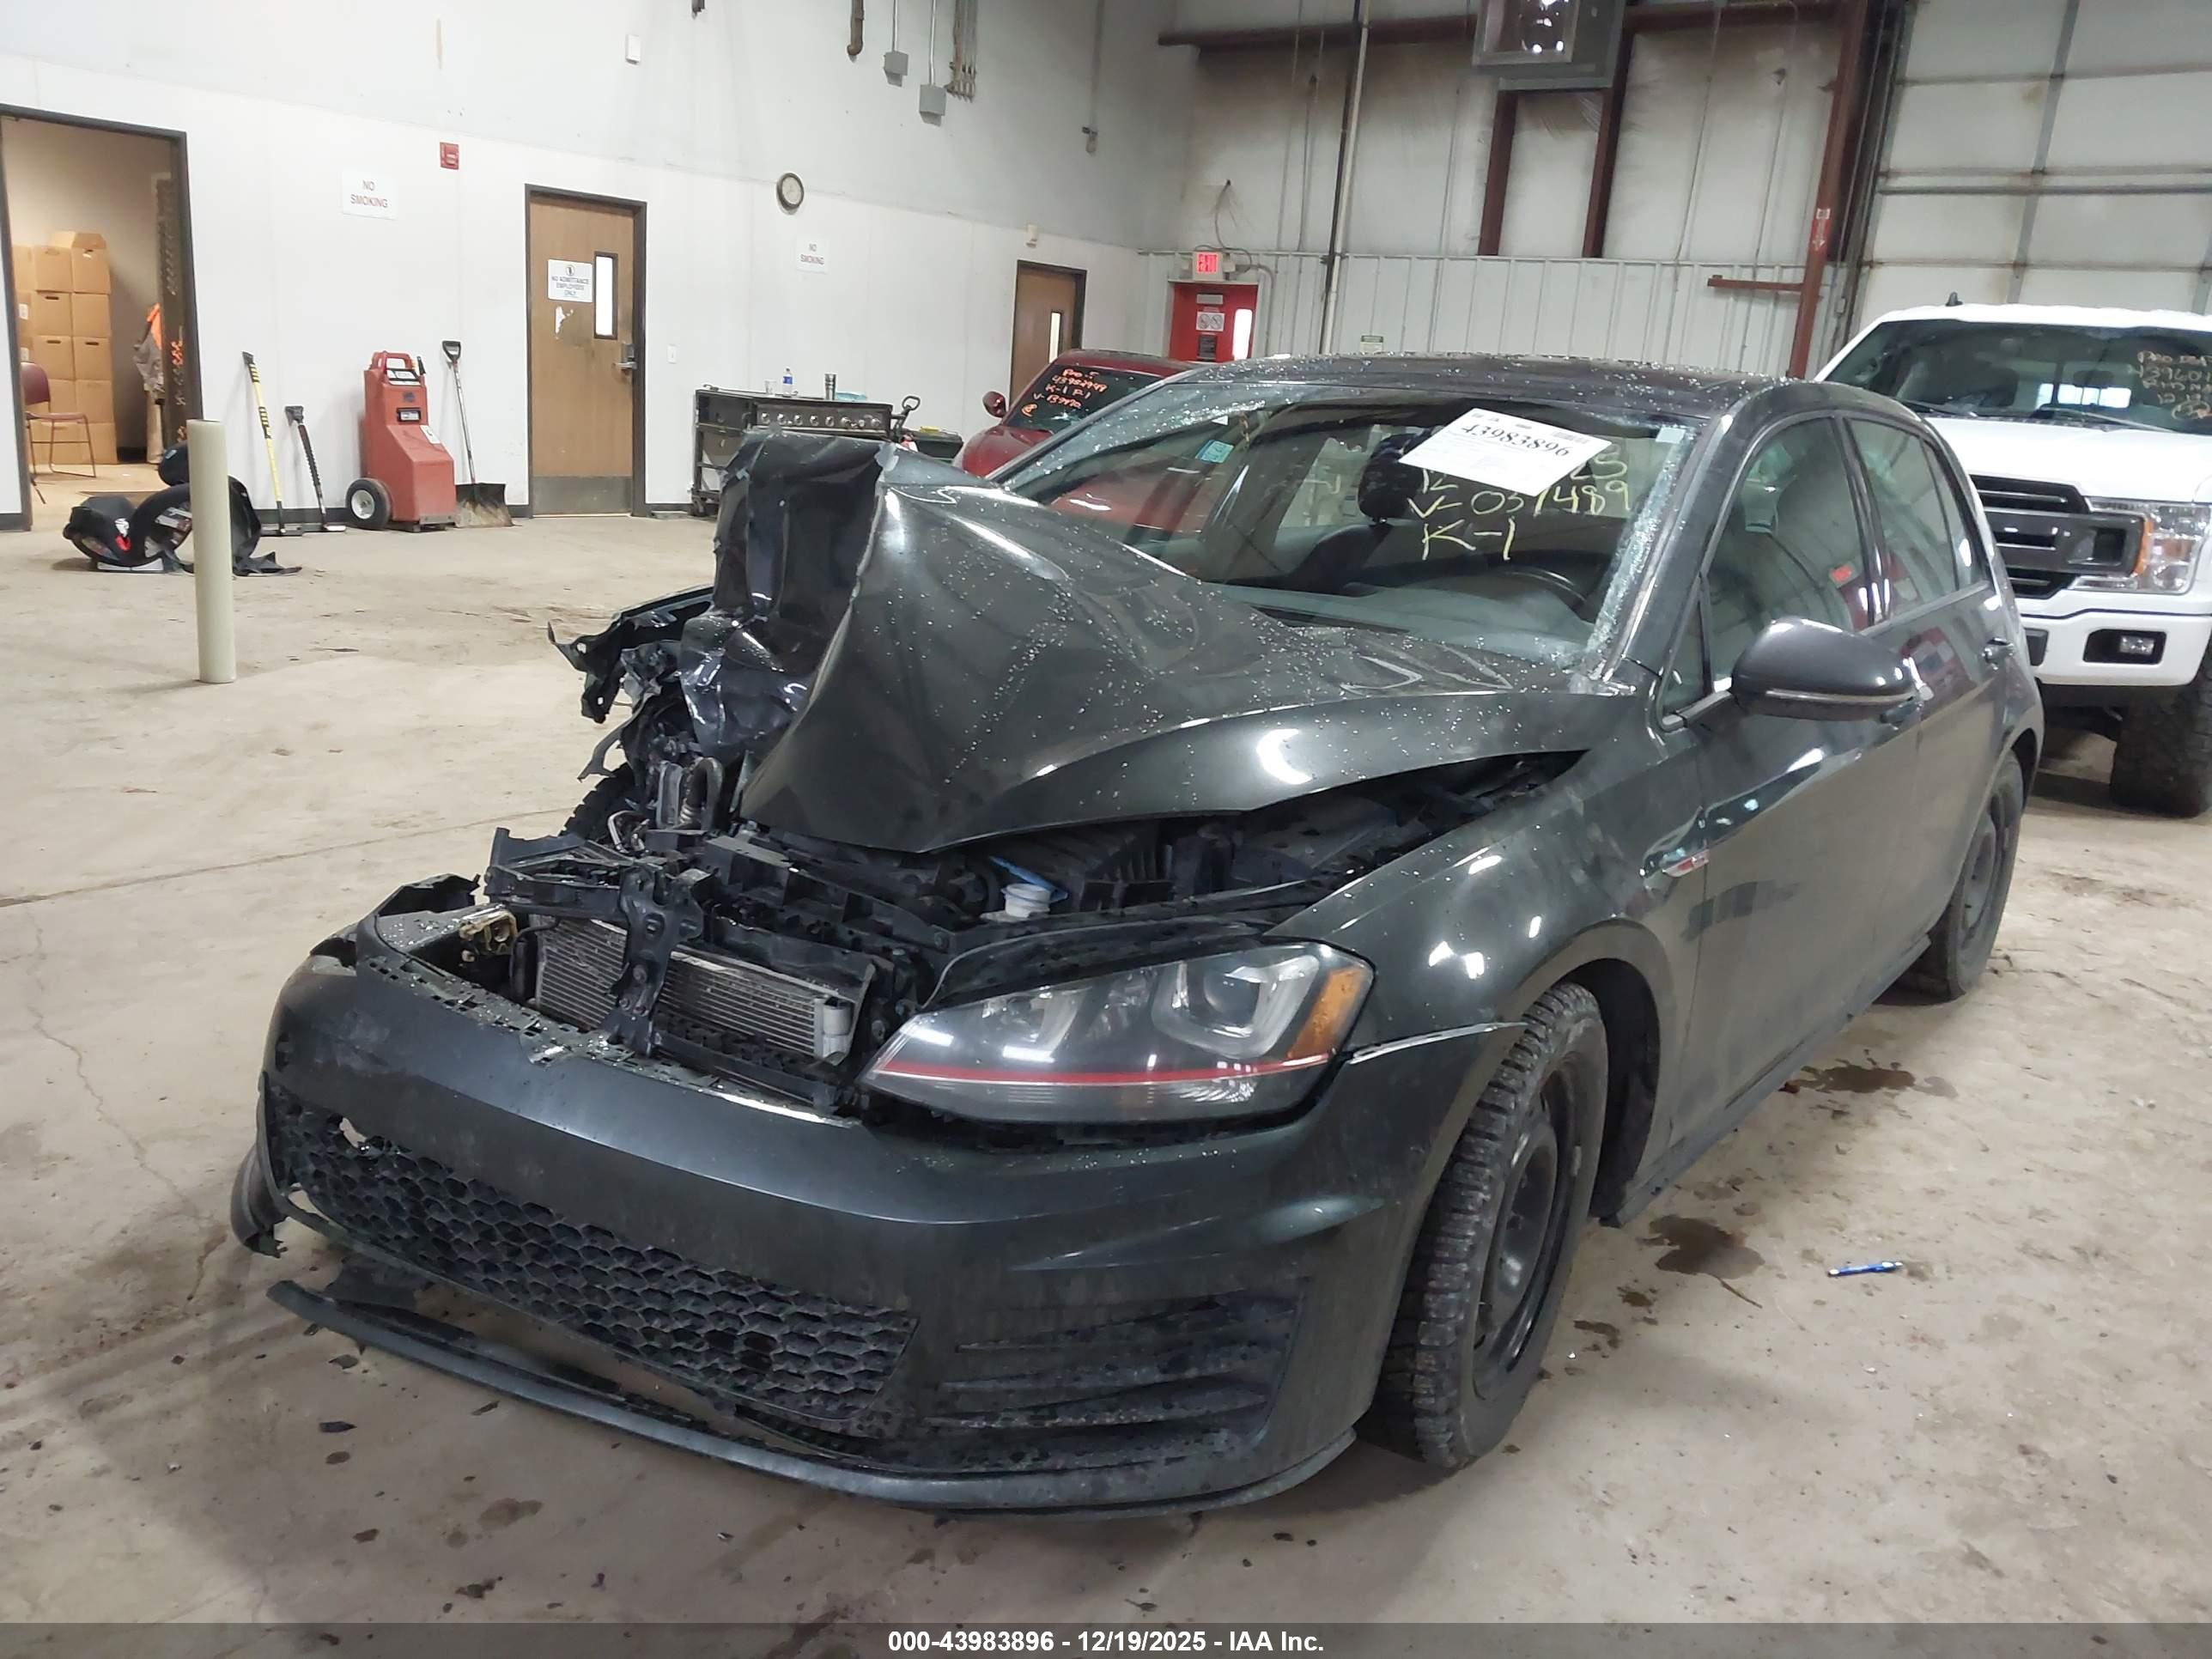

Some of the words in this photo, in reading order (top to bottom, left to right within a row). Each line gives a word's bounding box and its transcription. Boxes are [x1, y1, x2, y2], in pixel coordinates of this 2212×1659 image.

[362, 179, 375, 191] NO
[350, 193, 388, 208] SMOKING
[809, 243, 817, 252] NO
[800, 254, 825, 265] SMOKING
[1461, 424, 1572, 457] 43983896
[1421, 516, 1516, 562] K-1
